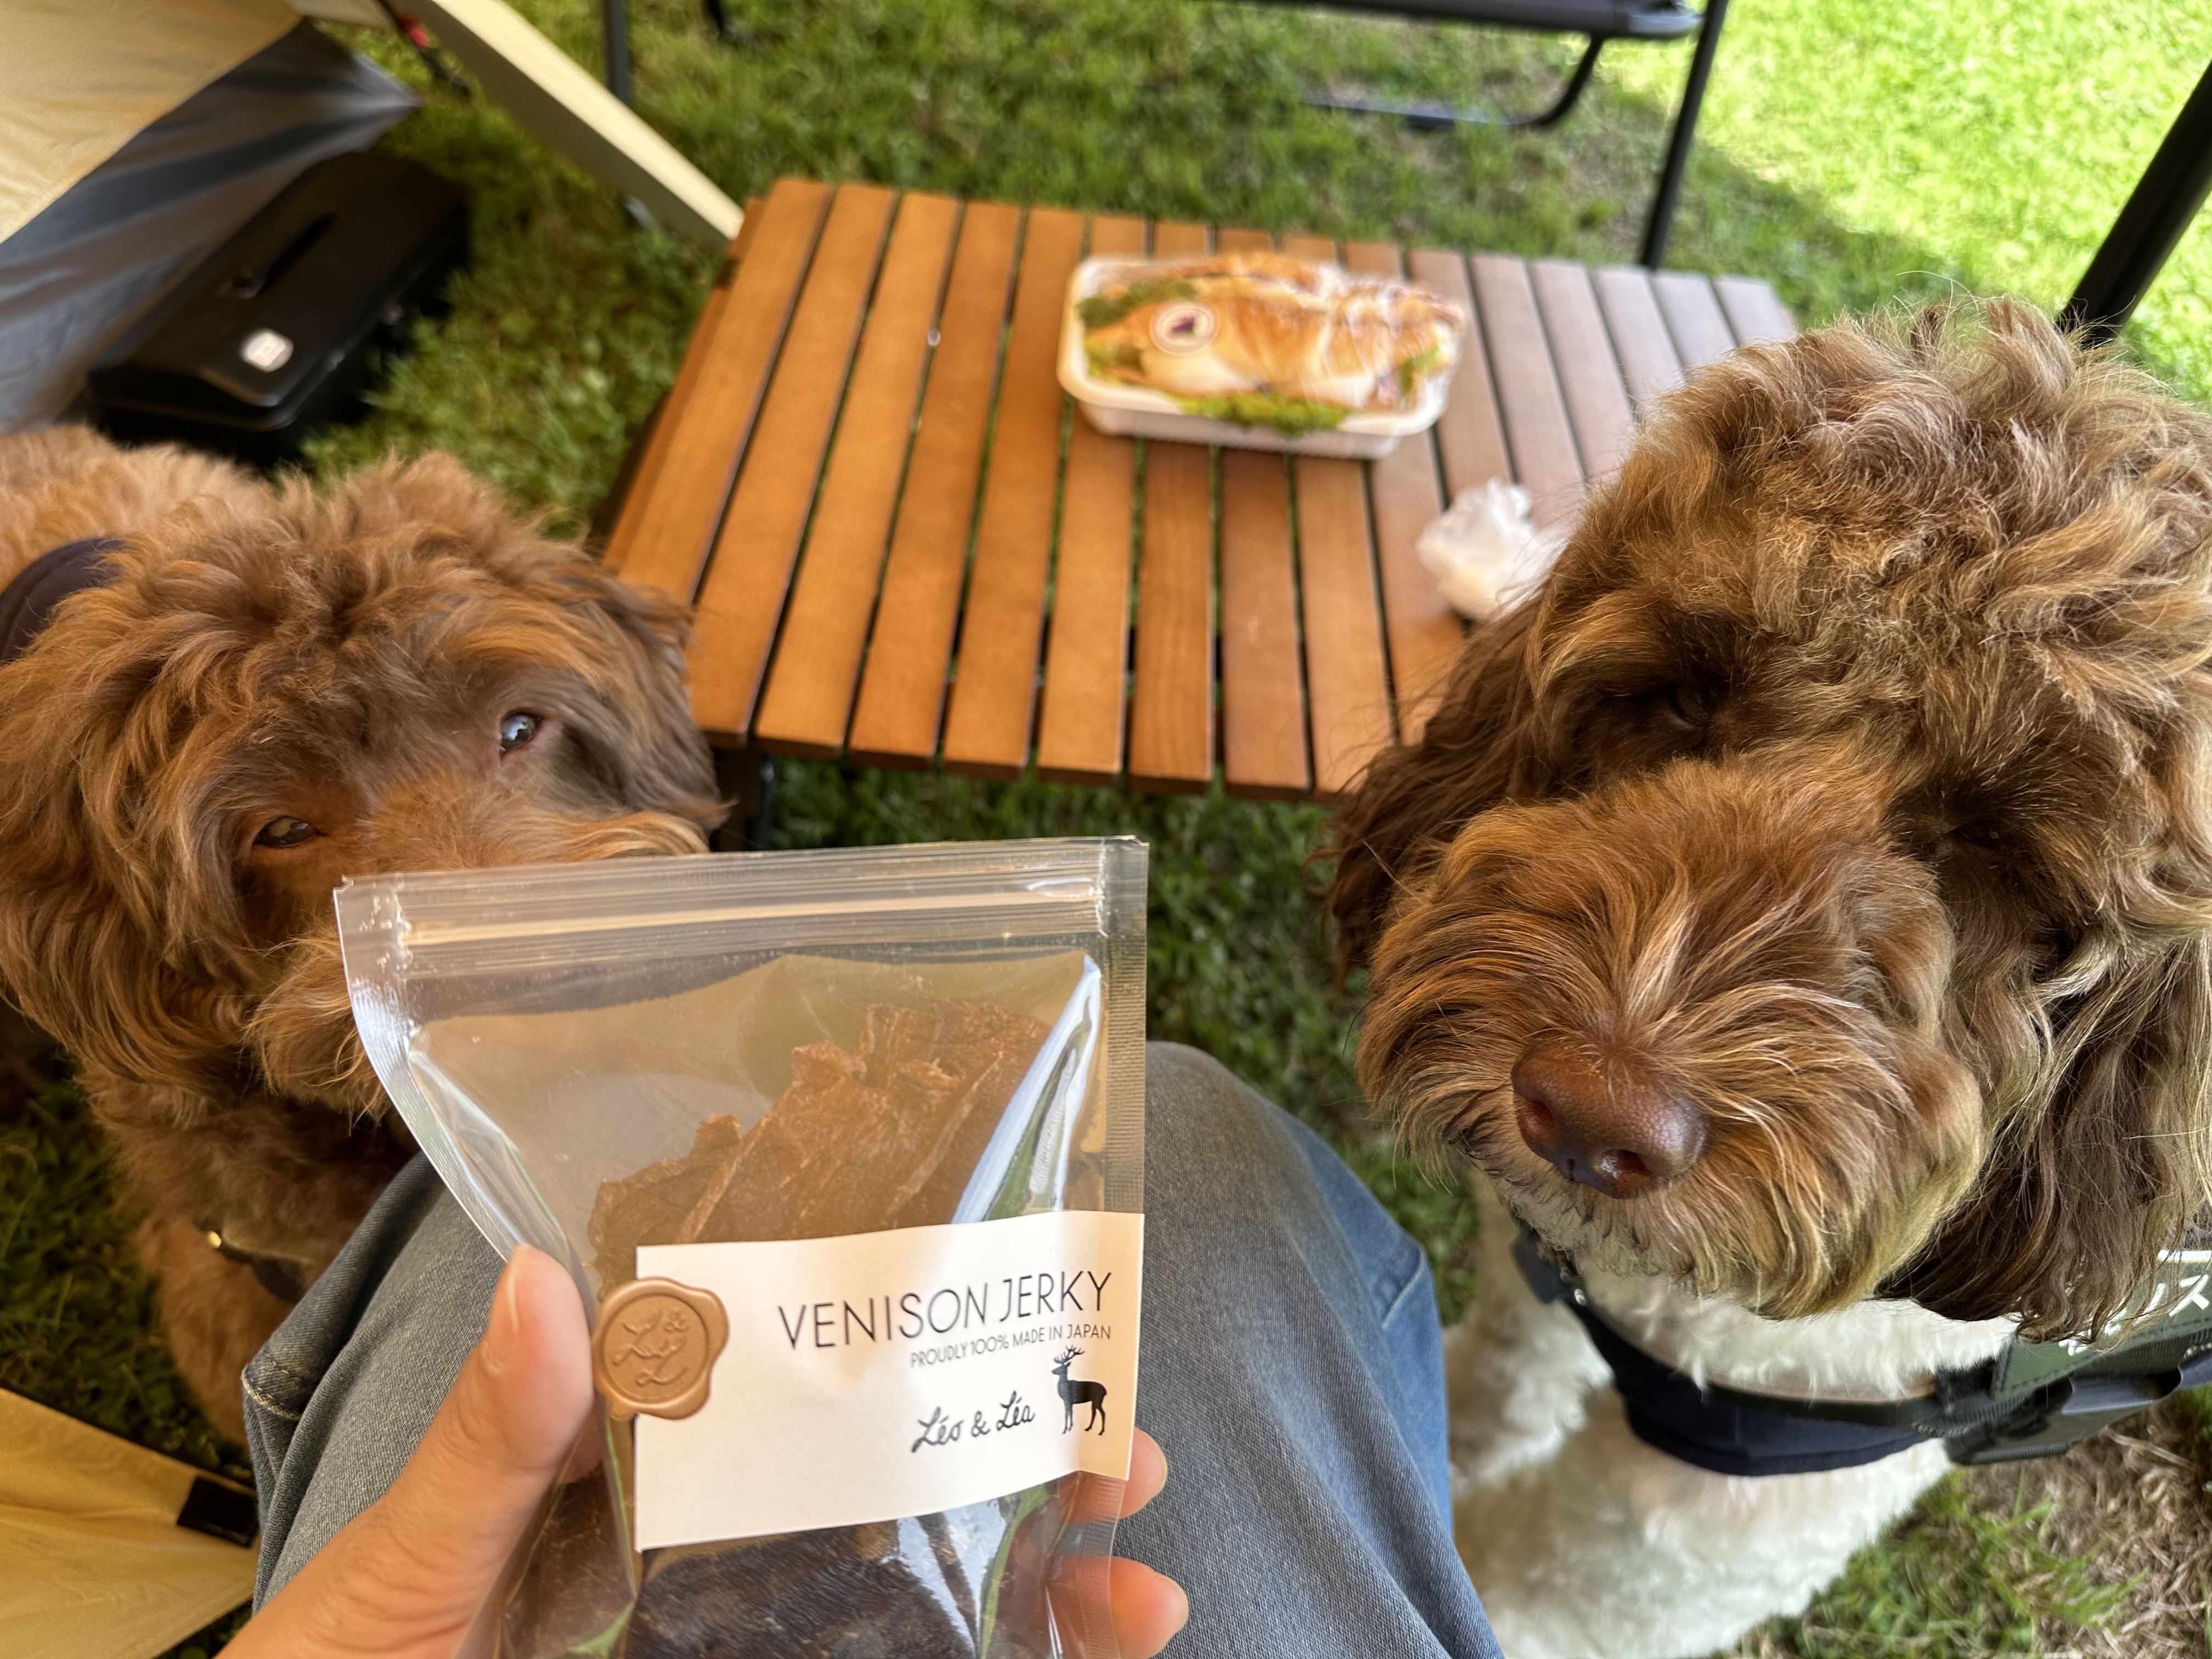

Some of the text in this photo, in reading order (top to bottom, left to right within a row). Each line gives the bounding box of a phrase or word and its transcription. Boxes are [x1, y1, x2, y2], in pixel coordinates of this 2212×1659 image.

[777, 1270, 1112, 1350] VENISON JERKY
[910, 1323, 1111, 1368] PROUDLY 100% MADE IN JAPAN
[970, 1410, 991, 1437] &
